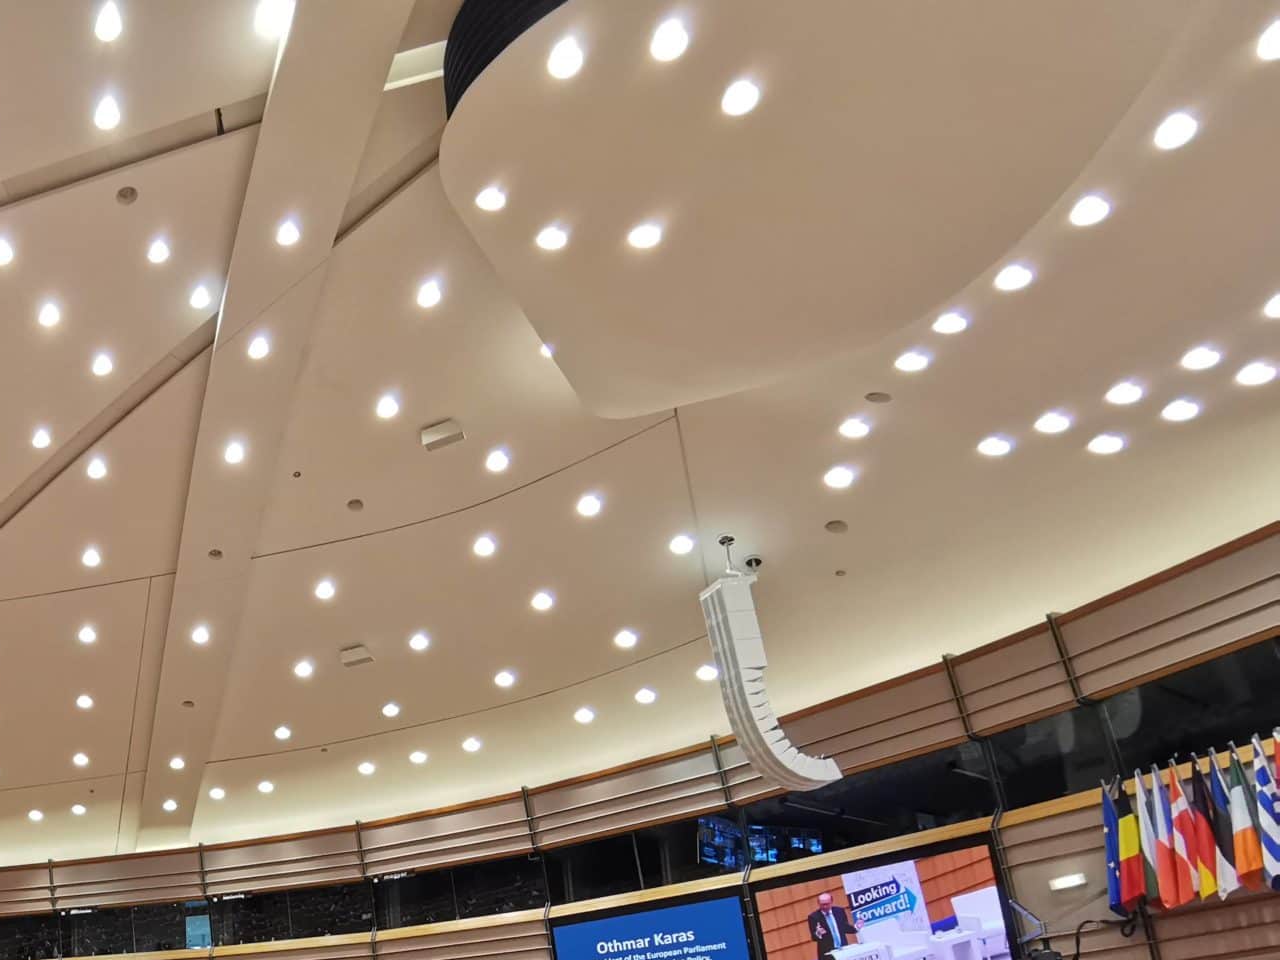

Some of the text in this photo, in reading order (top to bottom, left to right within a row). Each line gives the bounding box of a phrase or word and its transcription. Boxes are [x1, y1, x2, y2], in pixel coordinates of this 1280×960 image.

[851, 882, 897, 908] Looking
[856, 893, 910, 922] forward!
[596, 929, 695, 954] Othmar Karas
[633, 952, 645, 960] the
[646, 948, 682, 960] European
[683, 942, 727, 954] Parliament
